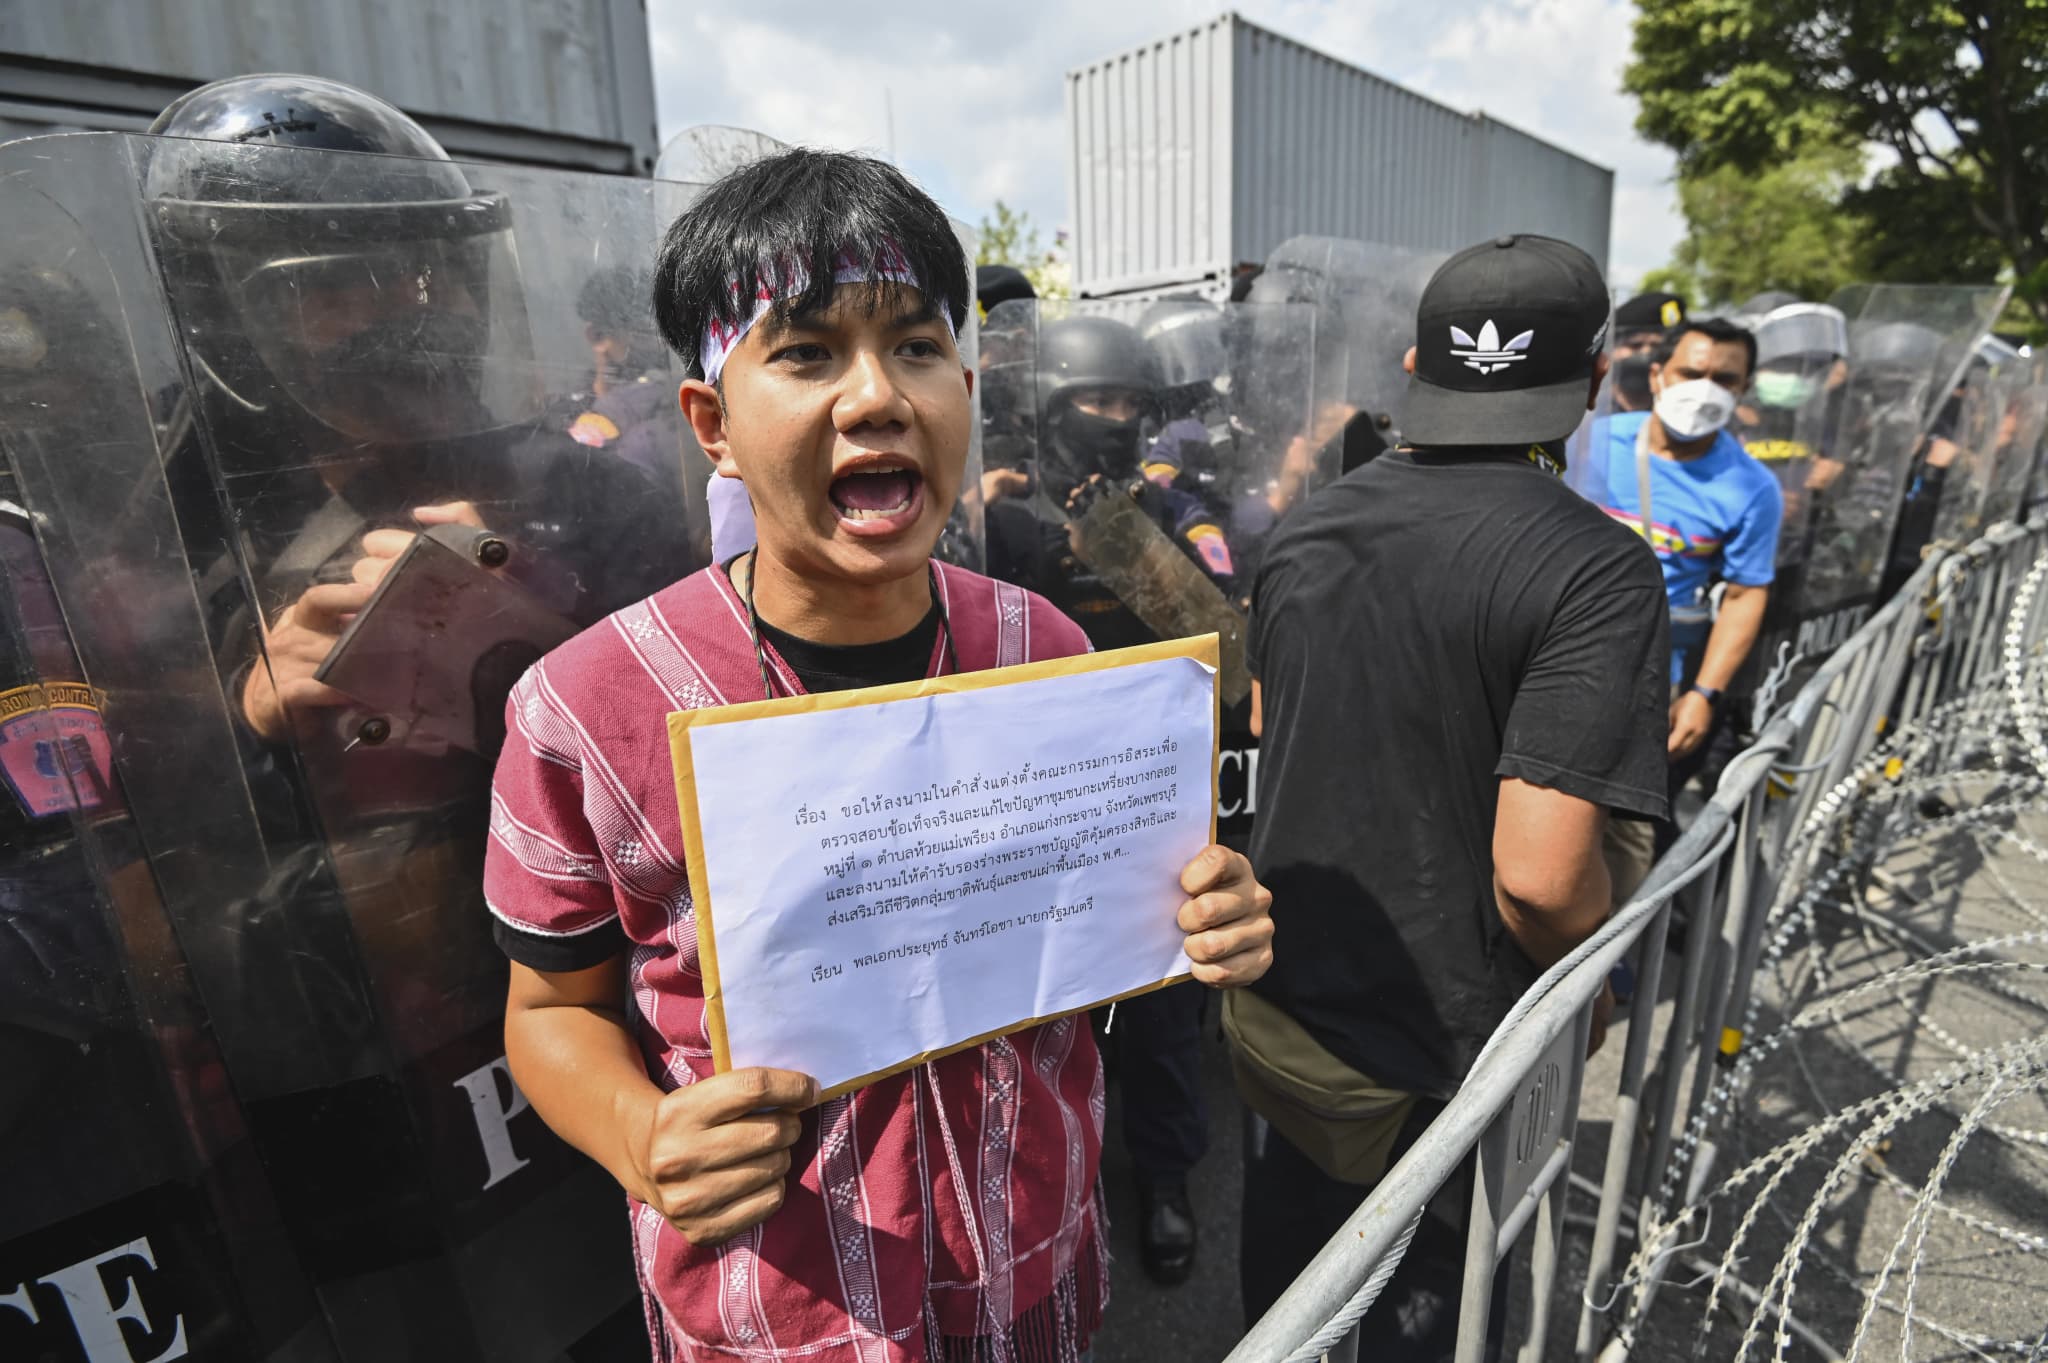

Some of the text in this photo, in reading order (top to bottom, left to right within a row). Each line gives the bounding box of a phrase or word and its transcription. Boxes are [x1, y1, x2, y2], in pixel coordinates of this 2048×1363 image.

[794, 803, 826, 825] เรื่อง
[823, 851, 856, 880] หมู่ที่
[1000, 806, 1102, 840] อำเภอแก่งกระจาน
[1105, 783, 1177, 816] จังหวัดเพชรบุรี
[810, 897, 1094, 983] เรียน พลเอกประยุทธ์ จันทร์โอชา นายกรัฐมนตรี
[0, 1236, 189, 1363] E
